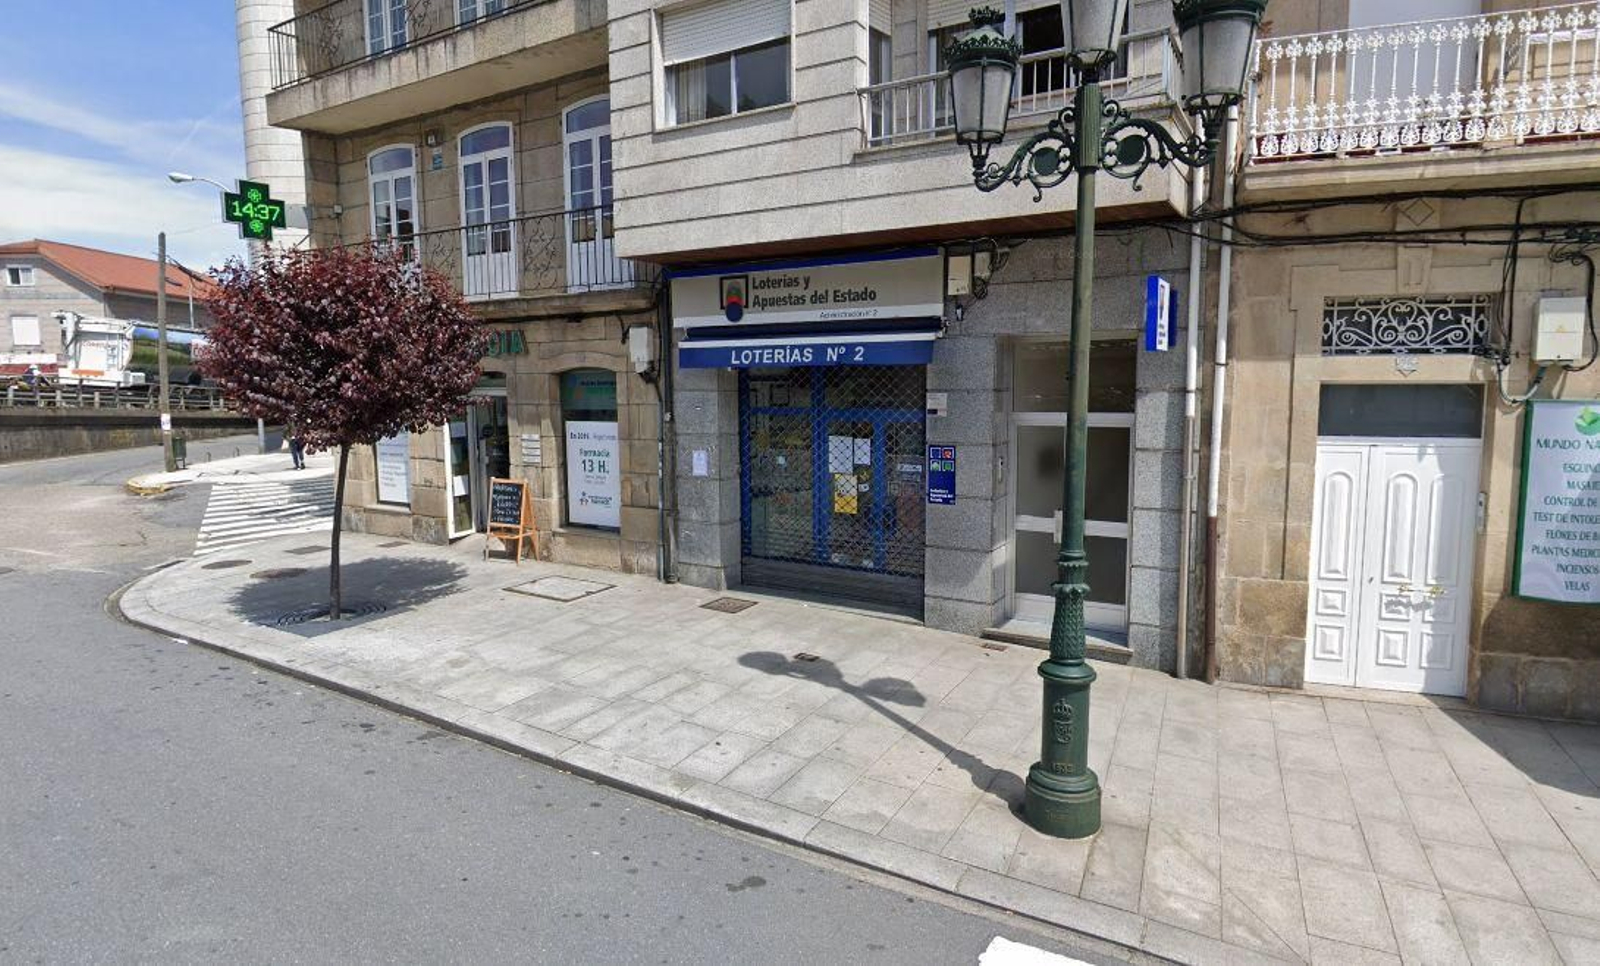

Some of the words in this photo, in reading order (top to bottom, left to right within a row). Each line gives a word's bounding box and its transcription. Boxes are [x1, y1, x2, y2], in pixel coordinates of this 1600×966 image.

[232, 200, 281, 221] 14:37
[752, 275, 800, 290] Loterías
[803, 276, 811, 290] y
[752, 294, 807, 311] Apuestas
[810, 290, 829, 304] del
[833, 287, 877, 303] Estado
[731, 345, 813, 365] LOTERÍAS
[853, 346, 865, 361] 2
[1536, 438, 1581, 450] MUNDO
[582, 459, 594, 473] 13
[1543, 495, 1586, 507] CONTROL
[1534, 512, 1554, 522] TEST
[1556, 513, 1569, 523] DE
[1546, 529, 1577, 541] FLORES
[1532, 544, 1569, 557] PLANTAS
[1564, 580, 1590, 592] VELAS
